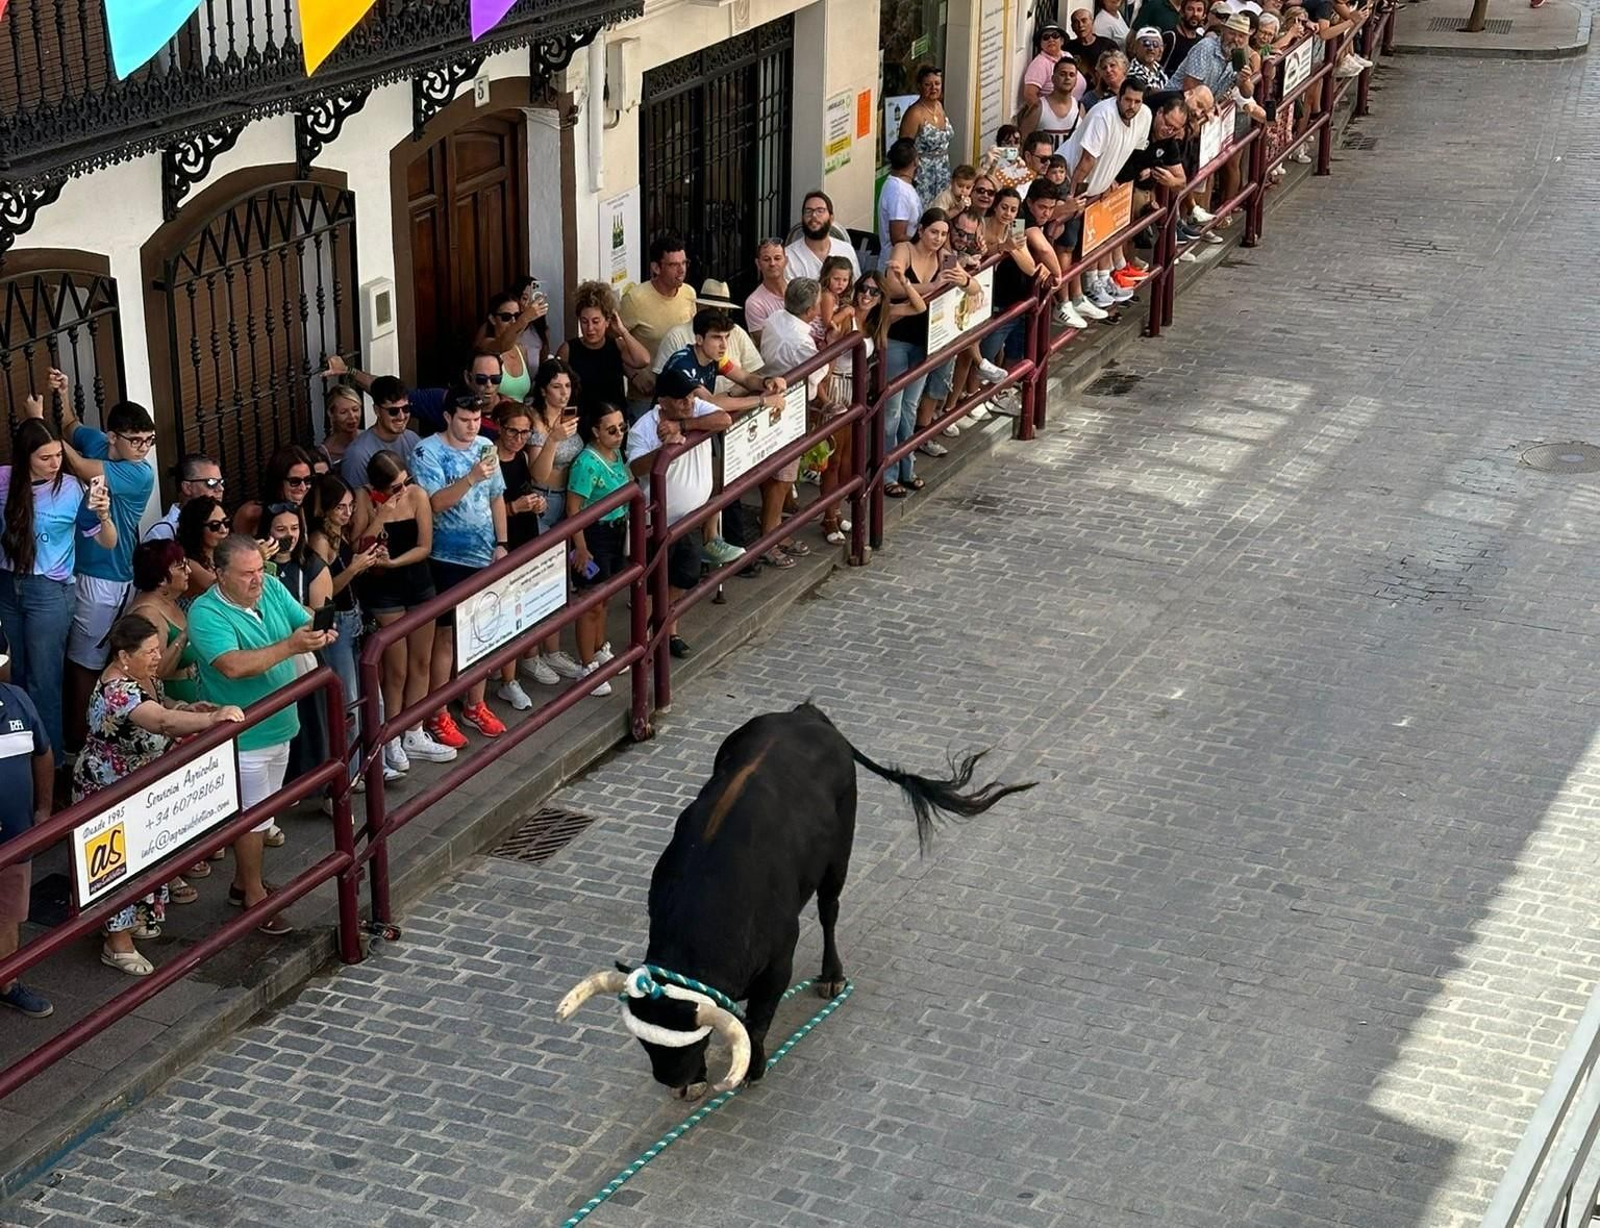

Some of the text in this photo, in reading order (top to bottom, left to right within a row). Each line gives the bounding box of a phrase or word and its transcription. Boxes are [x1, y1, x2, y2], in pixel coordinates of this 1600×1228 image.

[477, 80, 484, 100] 5
[146, 783, 179, 809] Servicios
[173, 773, 225, 815] 607981681
[83, 806, 125, 839] Desde 1995
